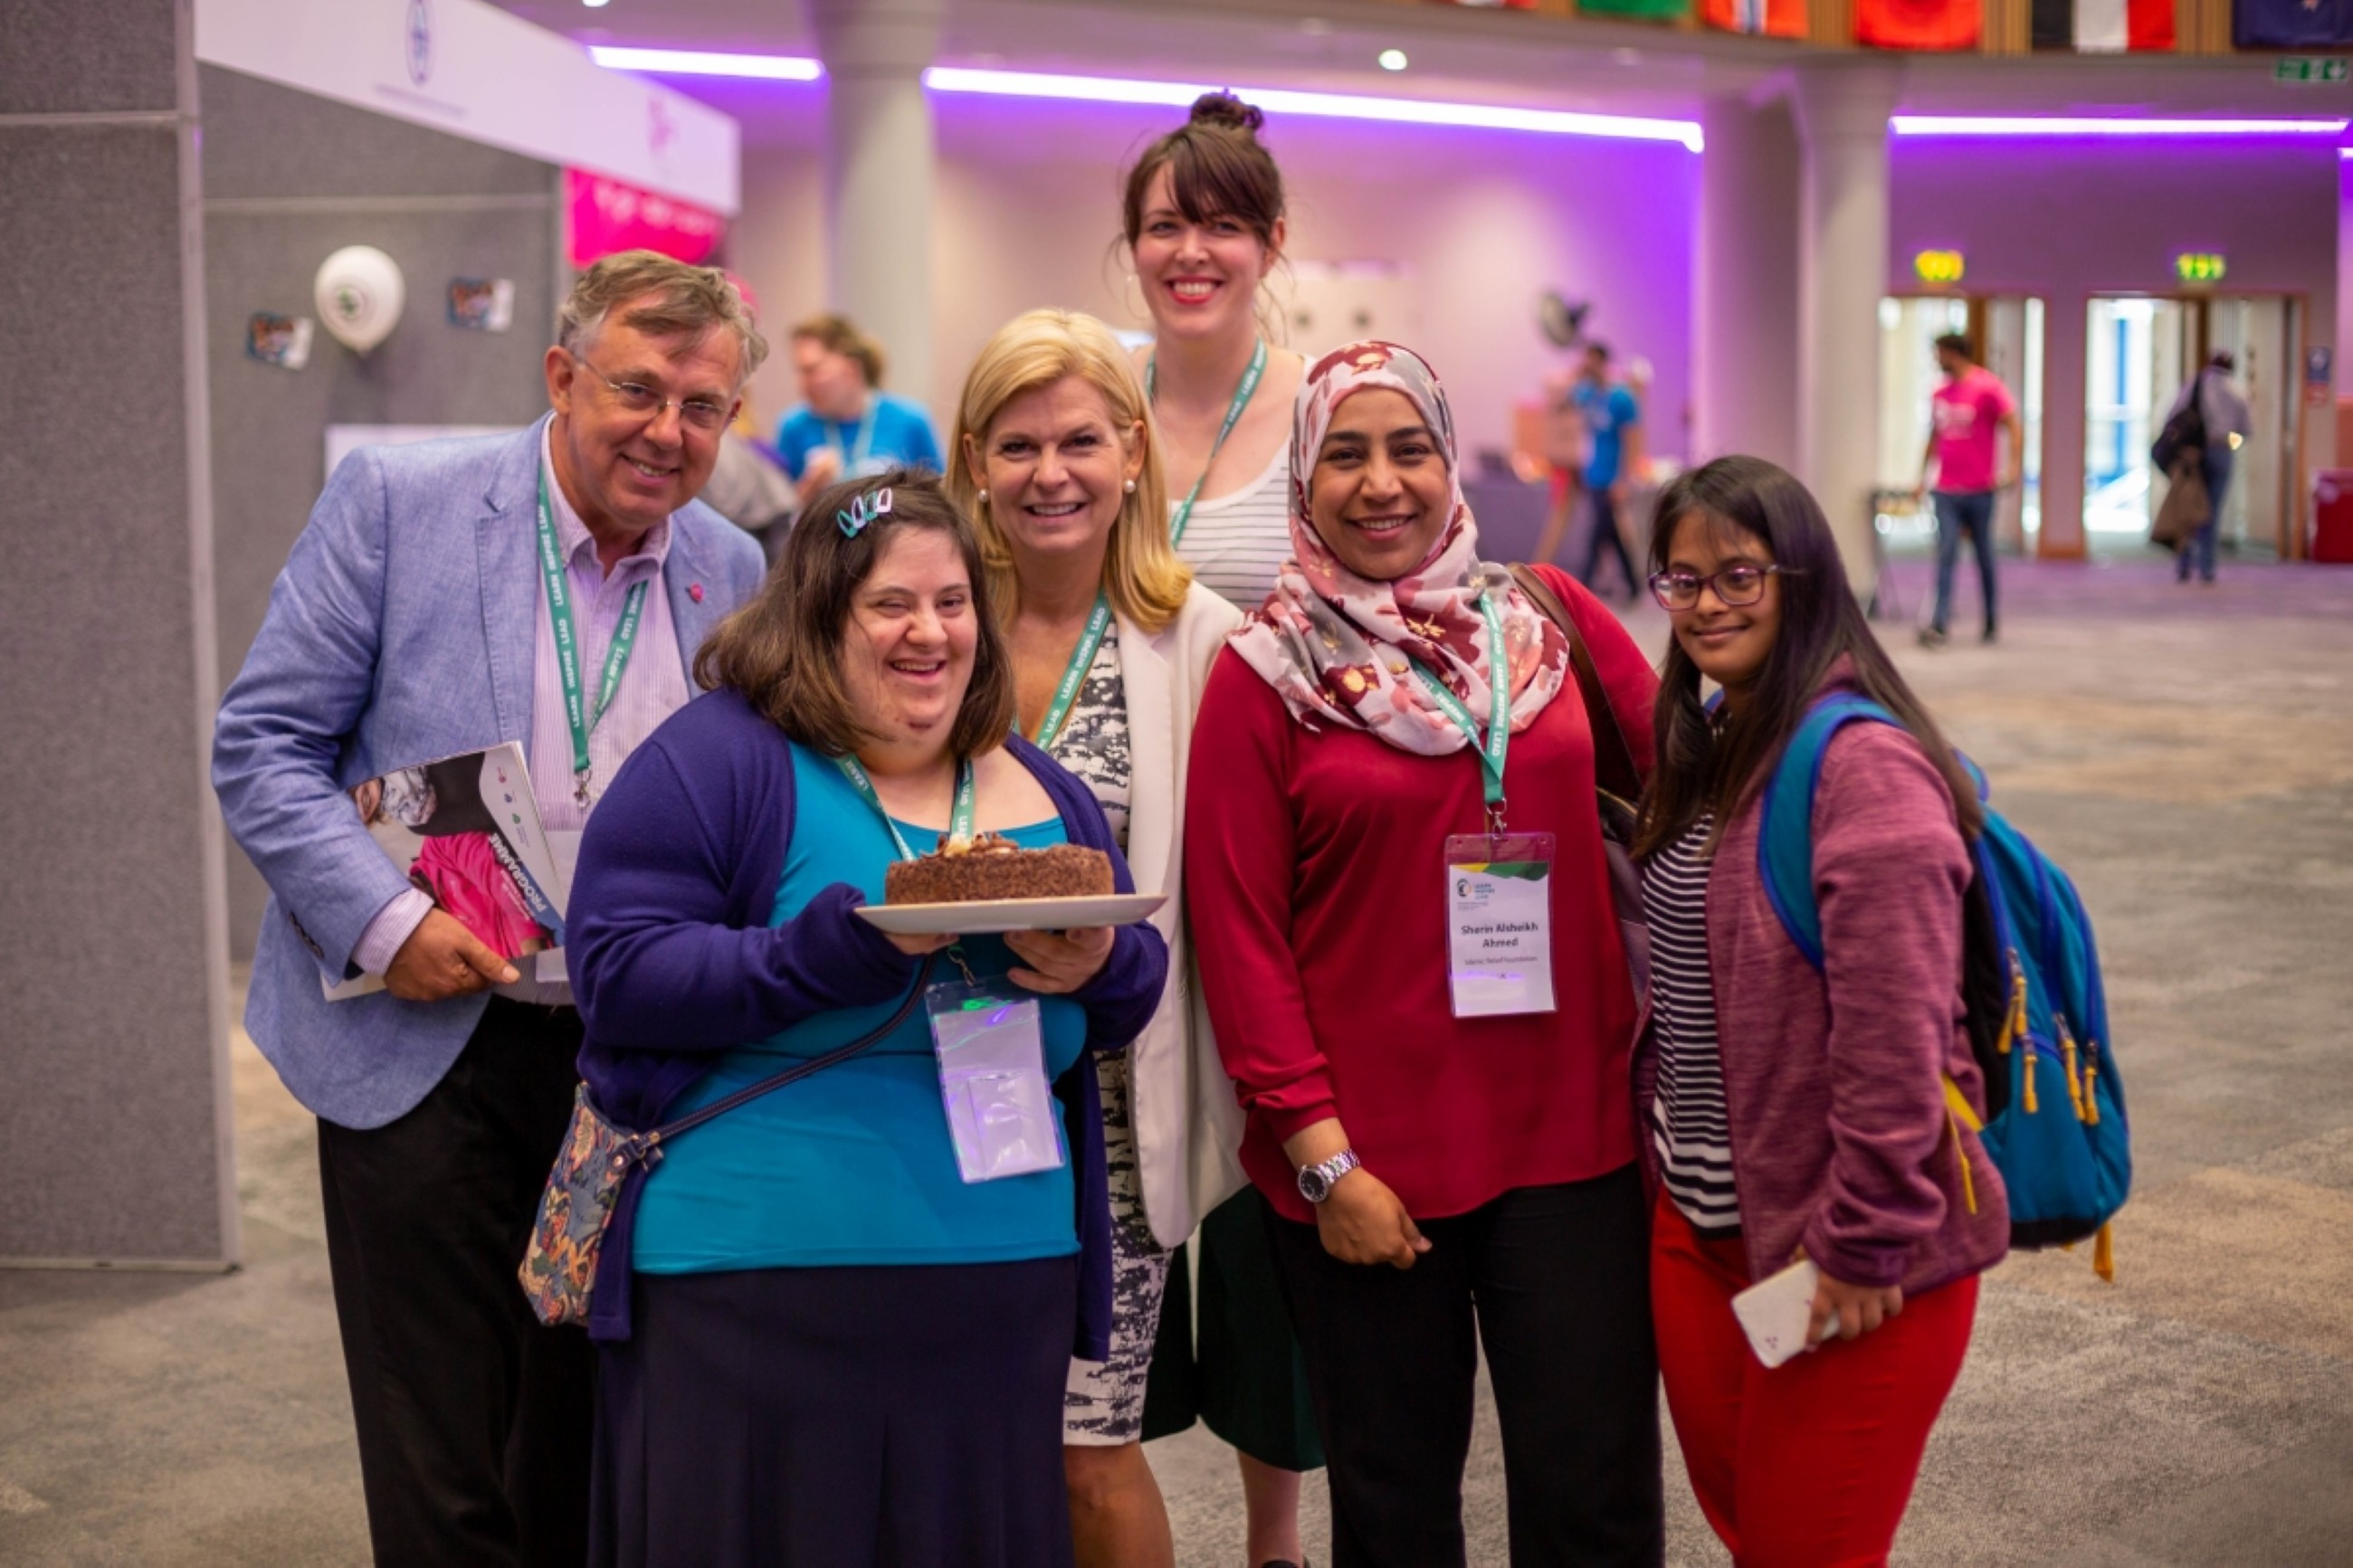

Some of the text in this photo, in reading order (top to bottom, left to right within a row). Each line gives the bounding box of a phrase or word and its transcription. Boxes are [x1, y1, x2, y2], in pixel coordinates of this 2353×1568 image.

[542, 533, 557, 571] INSPIRE
[551, 574, 563, 606] LEARN
[621, 617, 634, 641] LEAD
[609, 646, 624, 679] LEARN
[1062, 607, 1106, 699] LEARN INSPIRE LEAD
[558, 619, 580, 728] LEARN INSPIRE LEAD
[1045, 709, 1060, 733] LEAD
[1435, 692, 1465, 723] INSPIRE
[1492, 662, 1505, 757] LEARN INSPIRE LEAD
[844, 760, 870, 792] LEARN
[489, 832, 548, 912] PROGRAMME
[1482, 937, 1519, 948] Ahmed
